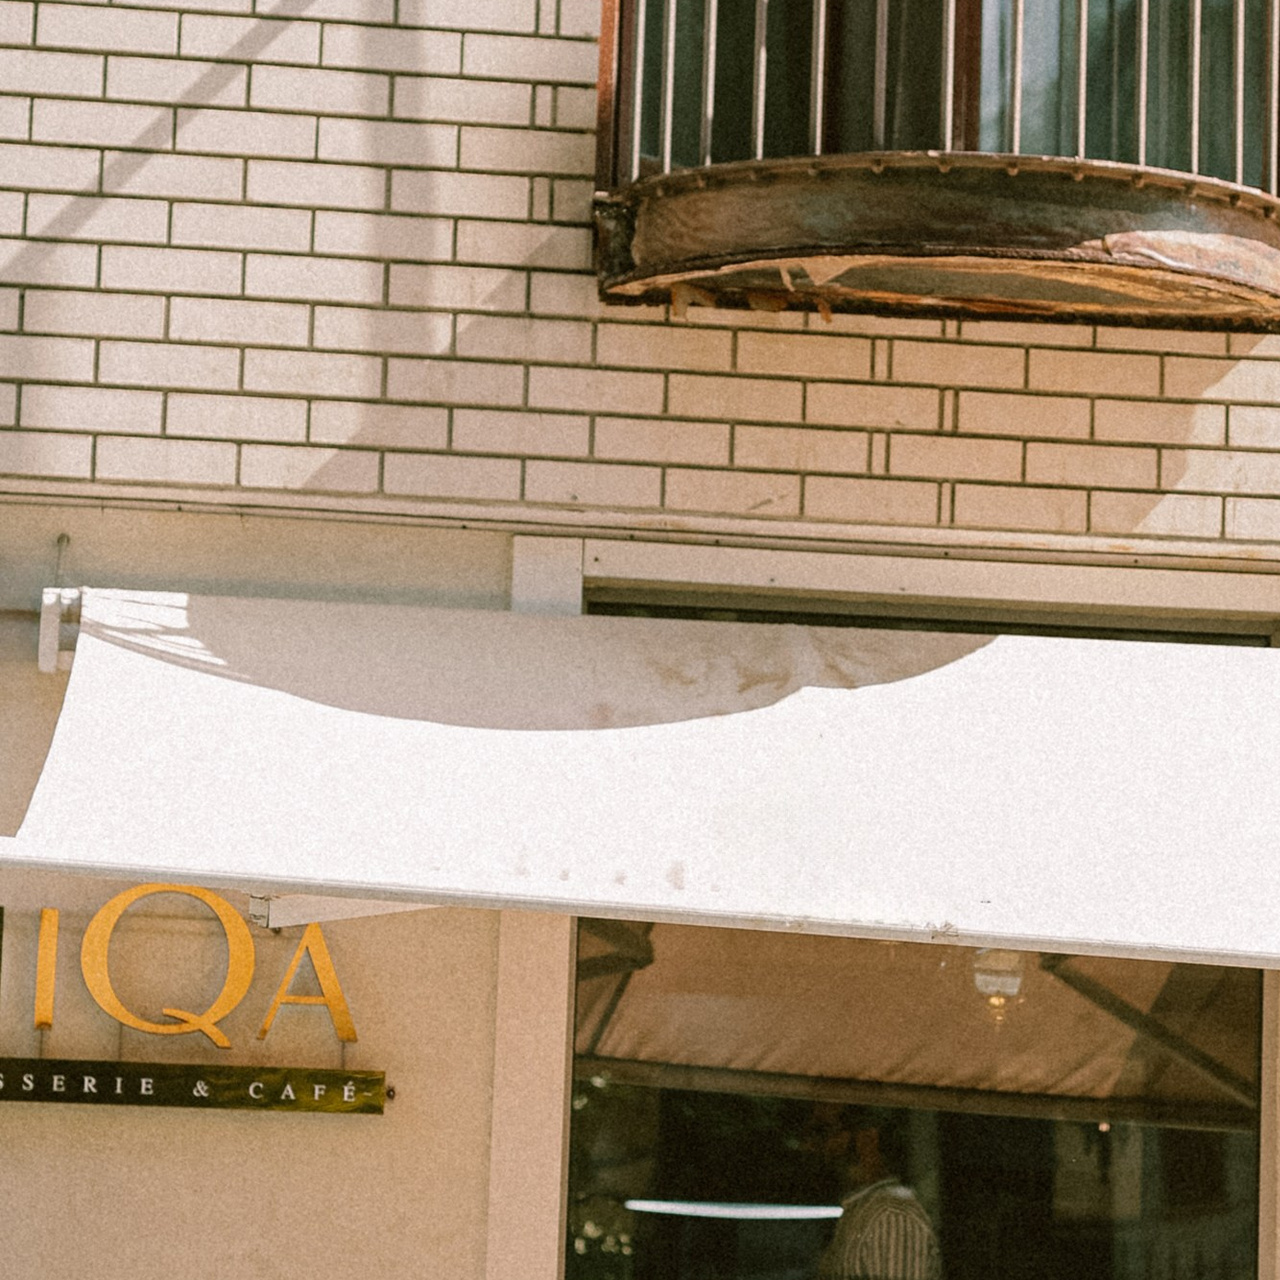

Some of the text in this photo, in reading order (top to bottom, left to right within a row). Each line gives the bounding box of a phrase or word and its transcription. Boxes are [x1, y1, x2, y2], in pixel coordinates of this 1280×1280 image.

[34, 882, 358, 1049] IQA
[192, 1080, 209, 1097] &
[248, 1081, 356, 1102] CAFÉ
